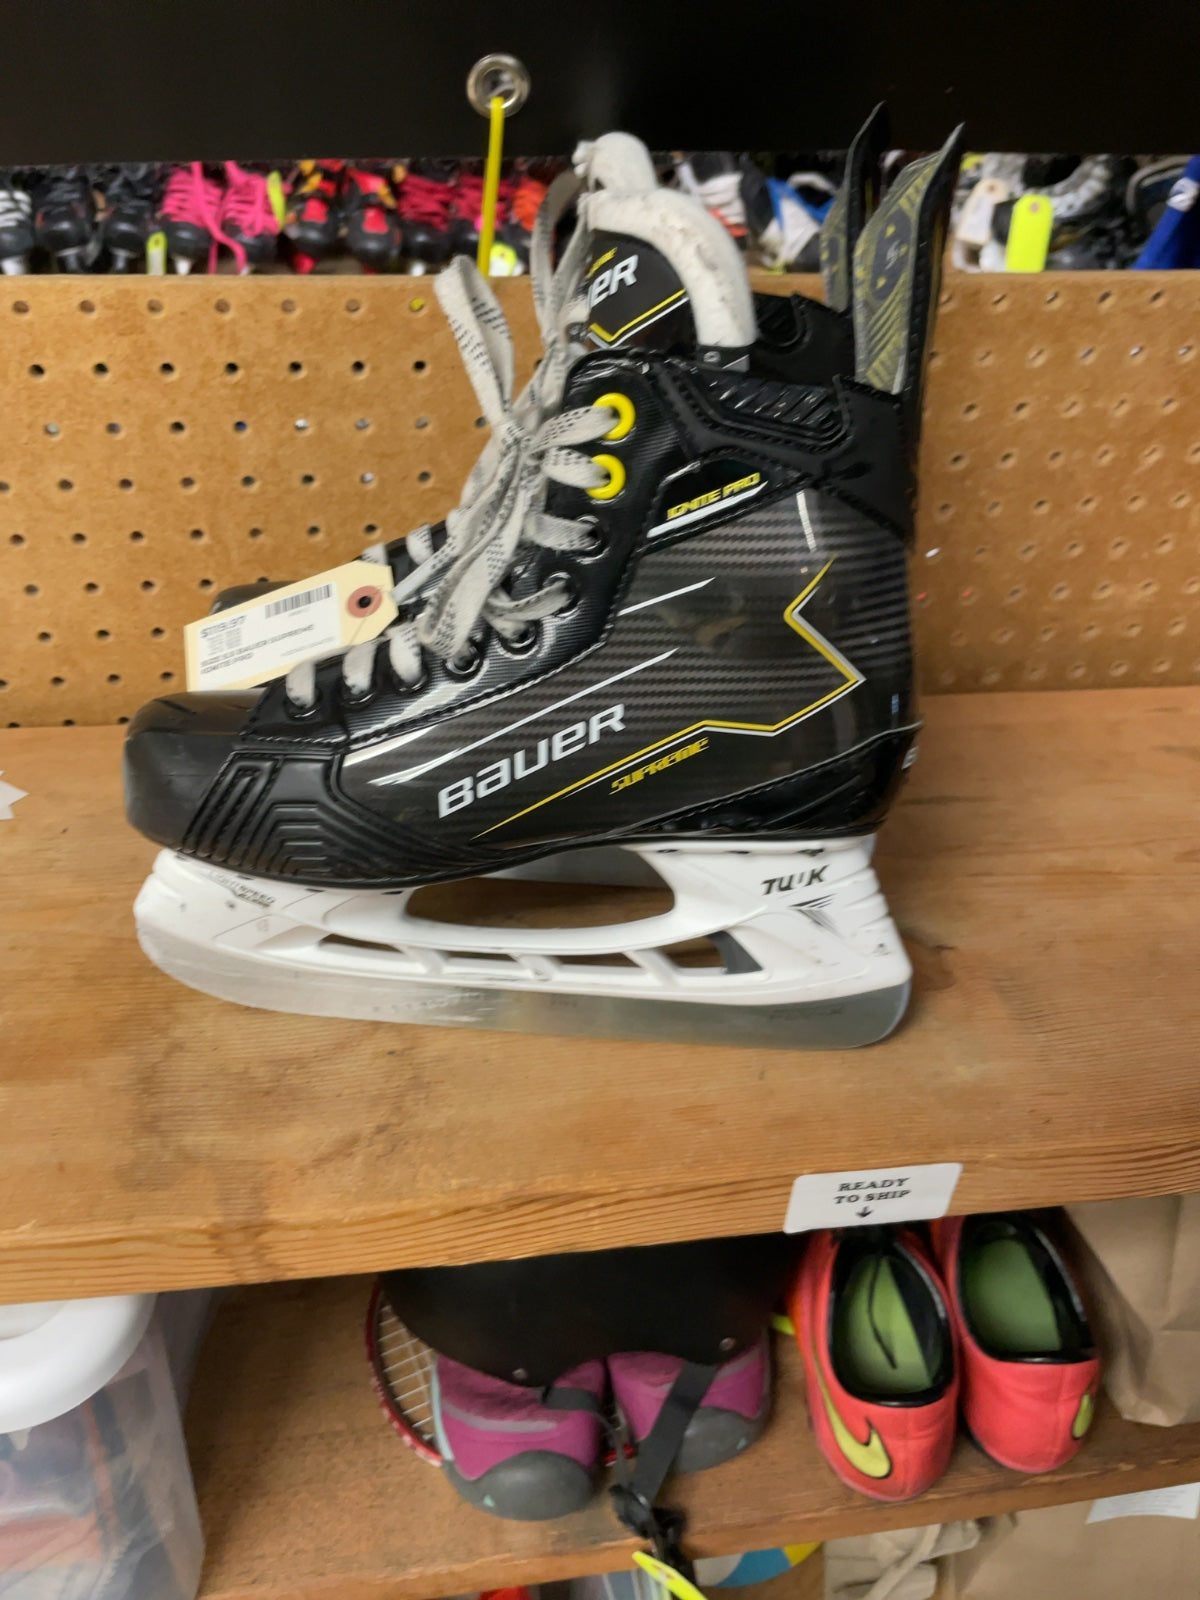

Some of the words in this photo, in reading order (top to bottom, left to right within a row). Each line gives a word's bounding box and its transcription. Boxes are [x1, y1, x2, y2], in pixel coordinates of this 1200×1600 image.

[588, 254, 638, 309] ER
[723, 472, 760, 498] PRO
[438, 704, 626, 819] BAUER
[609, 737, 709, 795] SUPREME
[833, 1195, 859, 1204] TO
[865, 1190, 911, 1202] SHIP
[838, 1178, 910, 1192] READY
